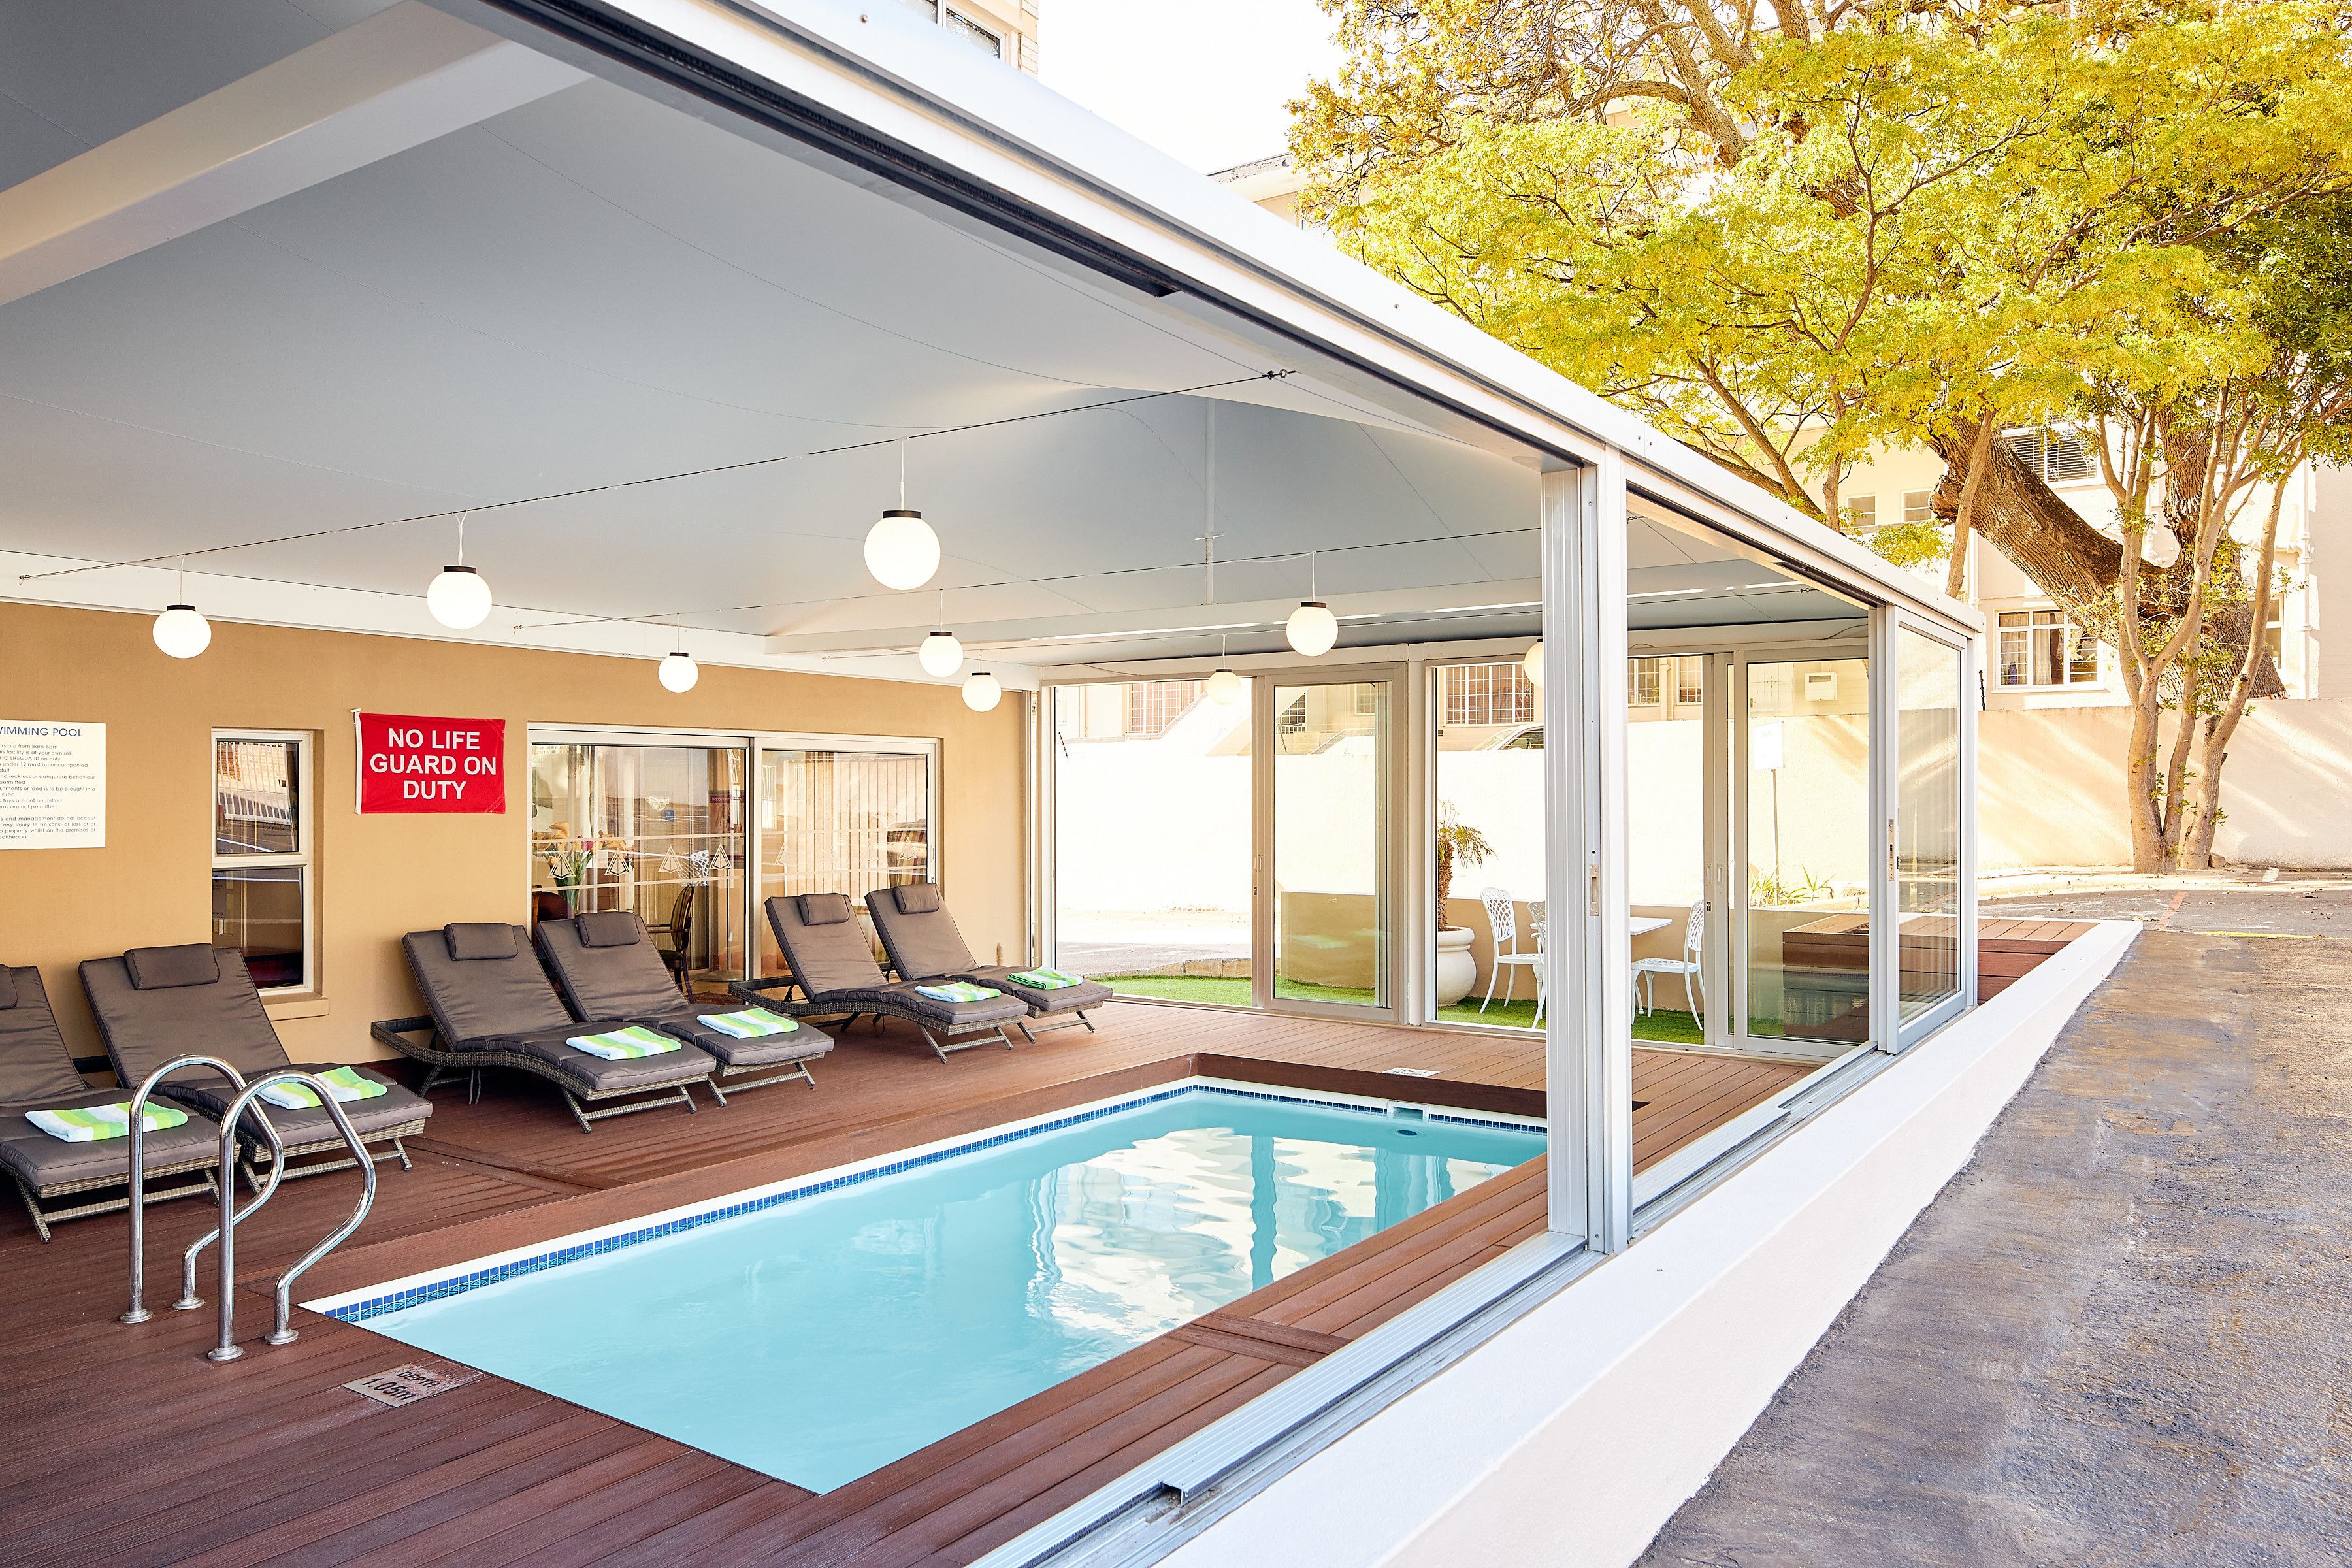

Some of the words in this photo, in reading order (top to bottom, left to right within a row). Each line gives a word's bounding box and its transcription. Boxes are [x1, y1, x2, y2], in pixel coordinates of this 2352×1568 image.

[0, 727, 49, 736] IMMING
[389, 728, 423, 748] NO
[432, 730, 480, 749] LIFE
[370, 754, 456, 774] GUARD
[464, 757, 496, 775] ON
[404, 780, 466, 800] DUTY
[362, 1377, 416, 1400] 1.05m
[397, 1371, 442, 1388] DEPTH
